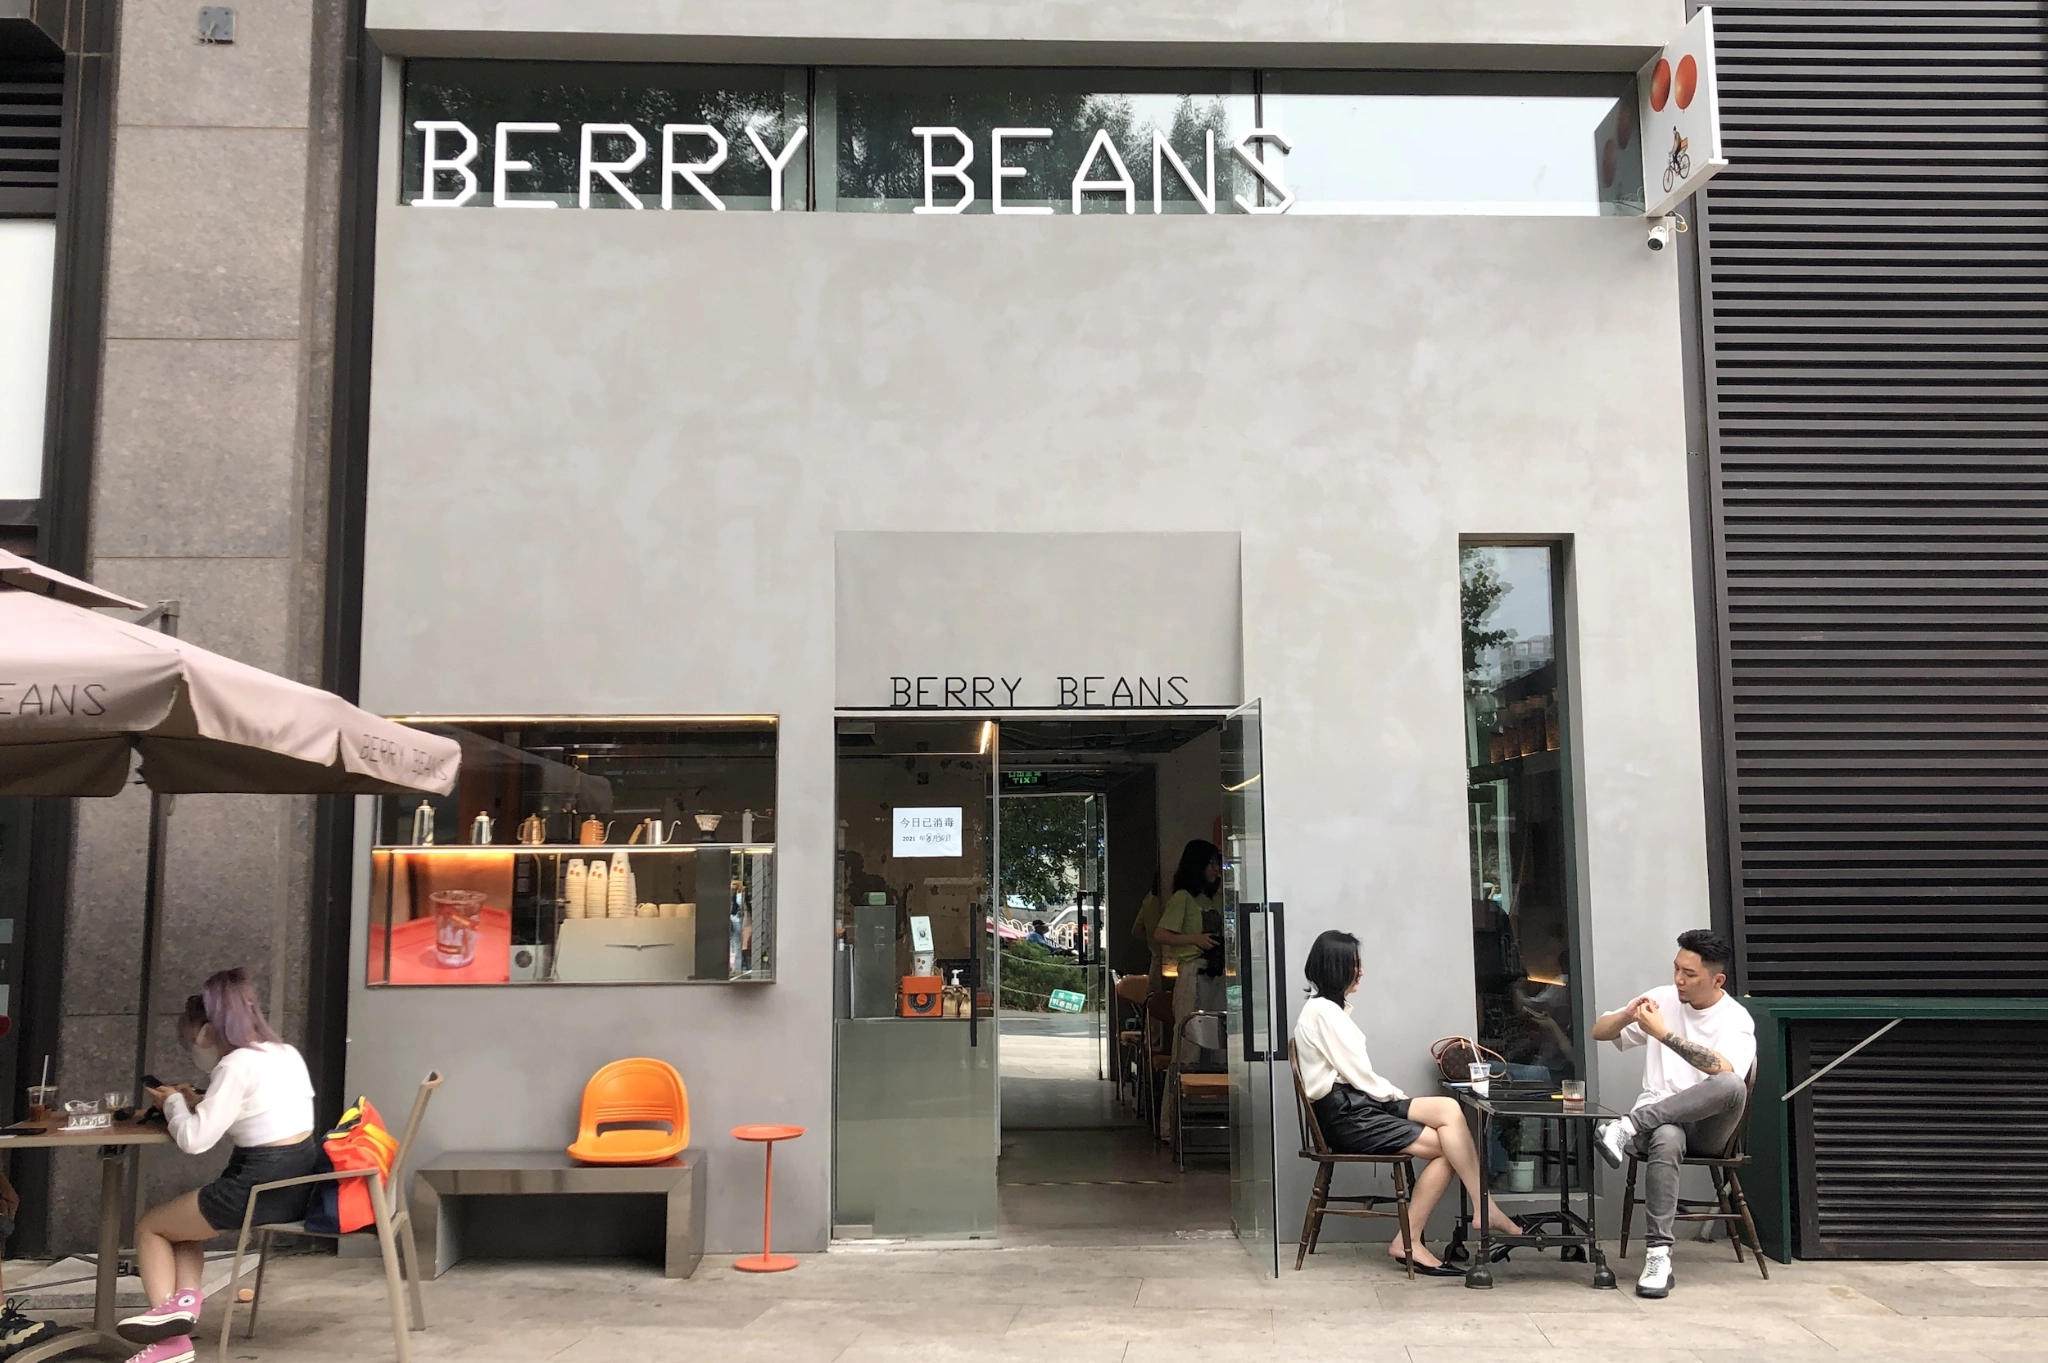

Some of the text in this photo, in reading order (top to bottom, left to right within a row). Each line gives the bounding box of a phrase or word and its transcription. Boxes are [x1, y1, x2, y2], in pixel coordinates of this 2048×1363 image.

[410, 120, 1296, 215] BERRY BEANS
[890, 676, 1189, 708] BERRY BEANS
[359, 733, 405, 767] BERRY
[900, 817, 954, 828] 今日已消毒
